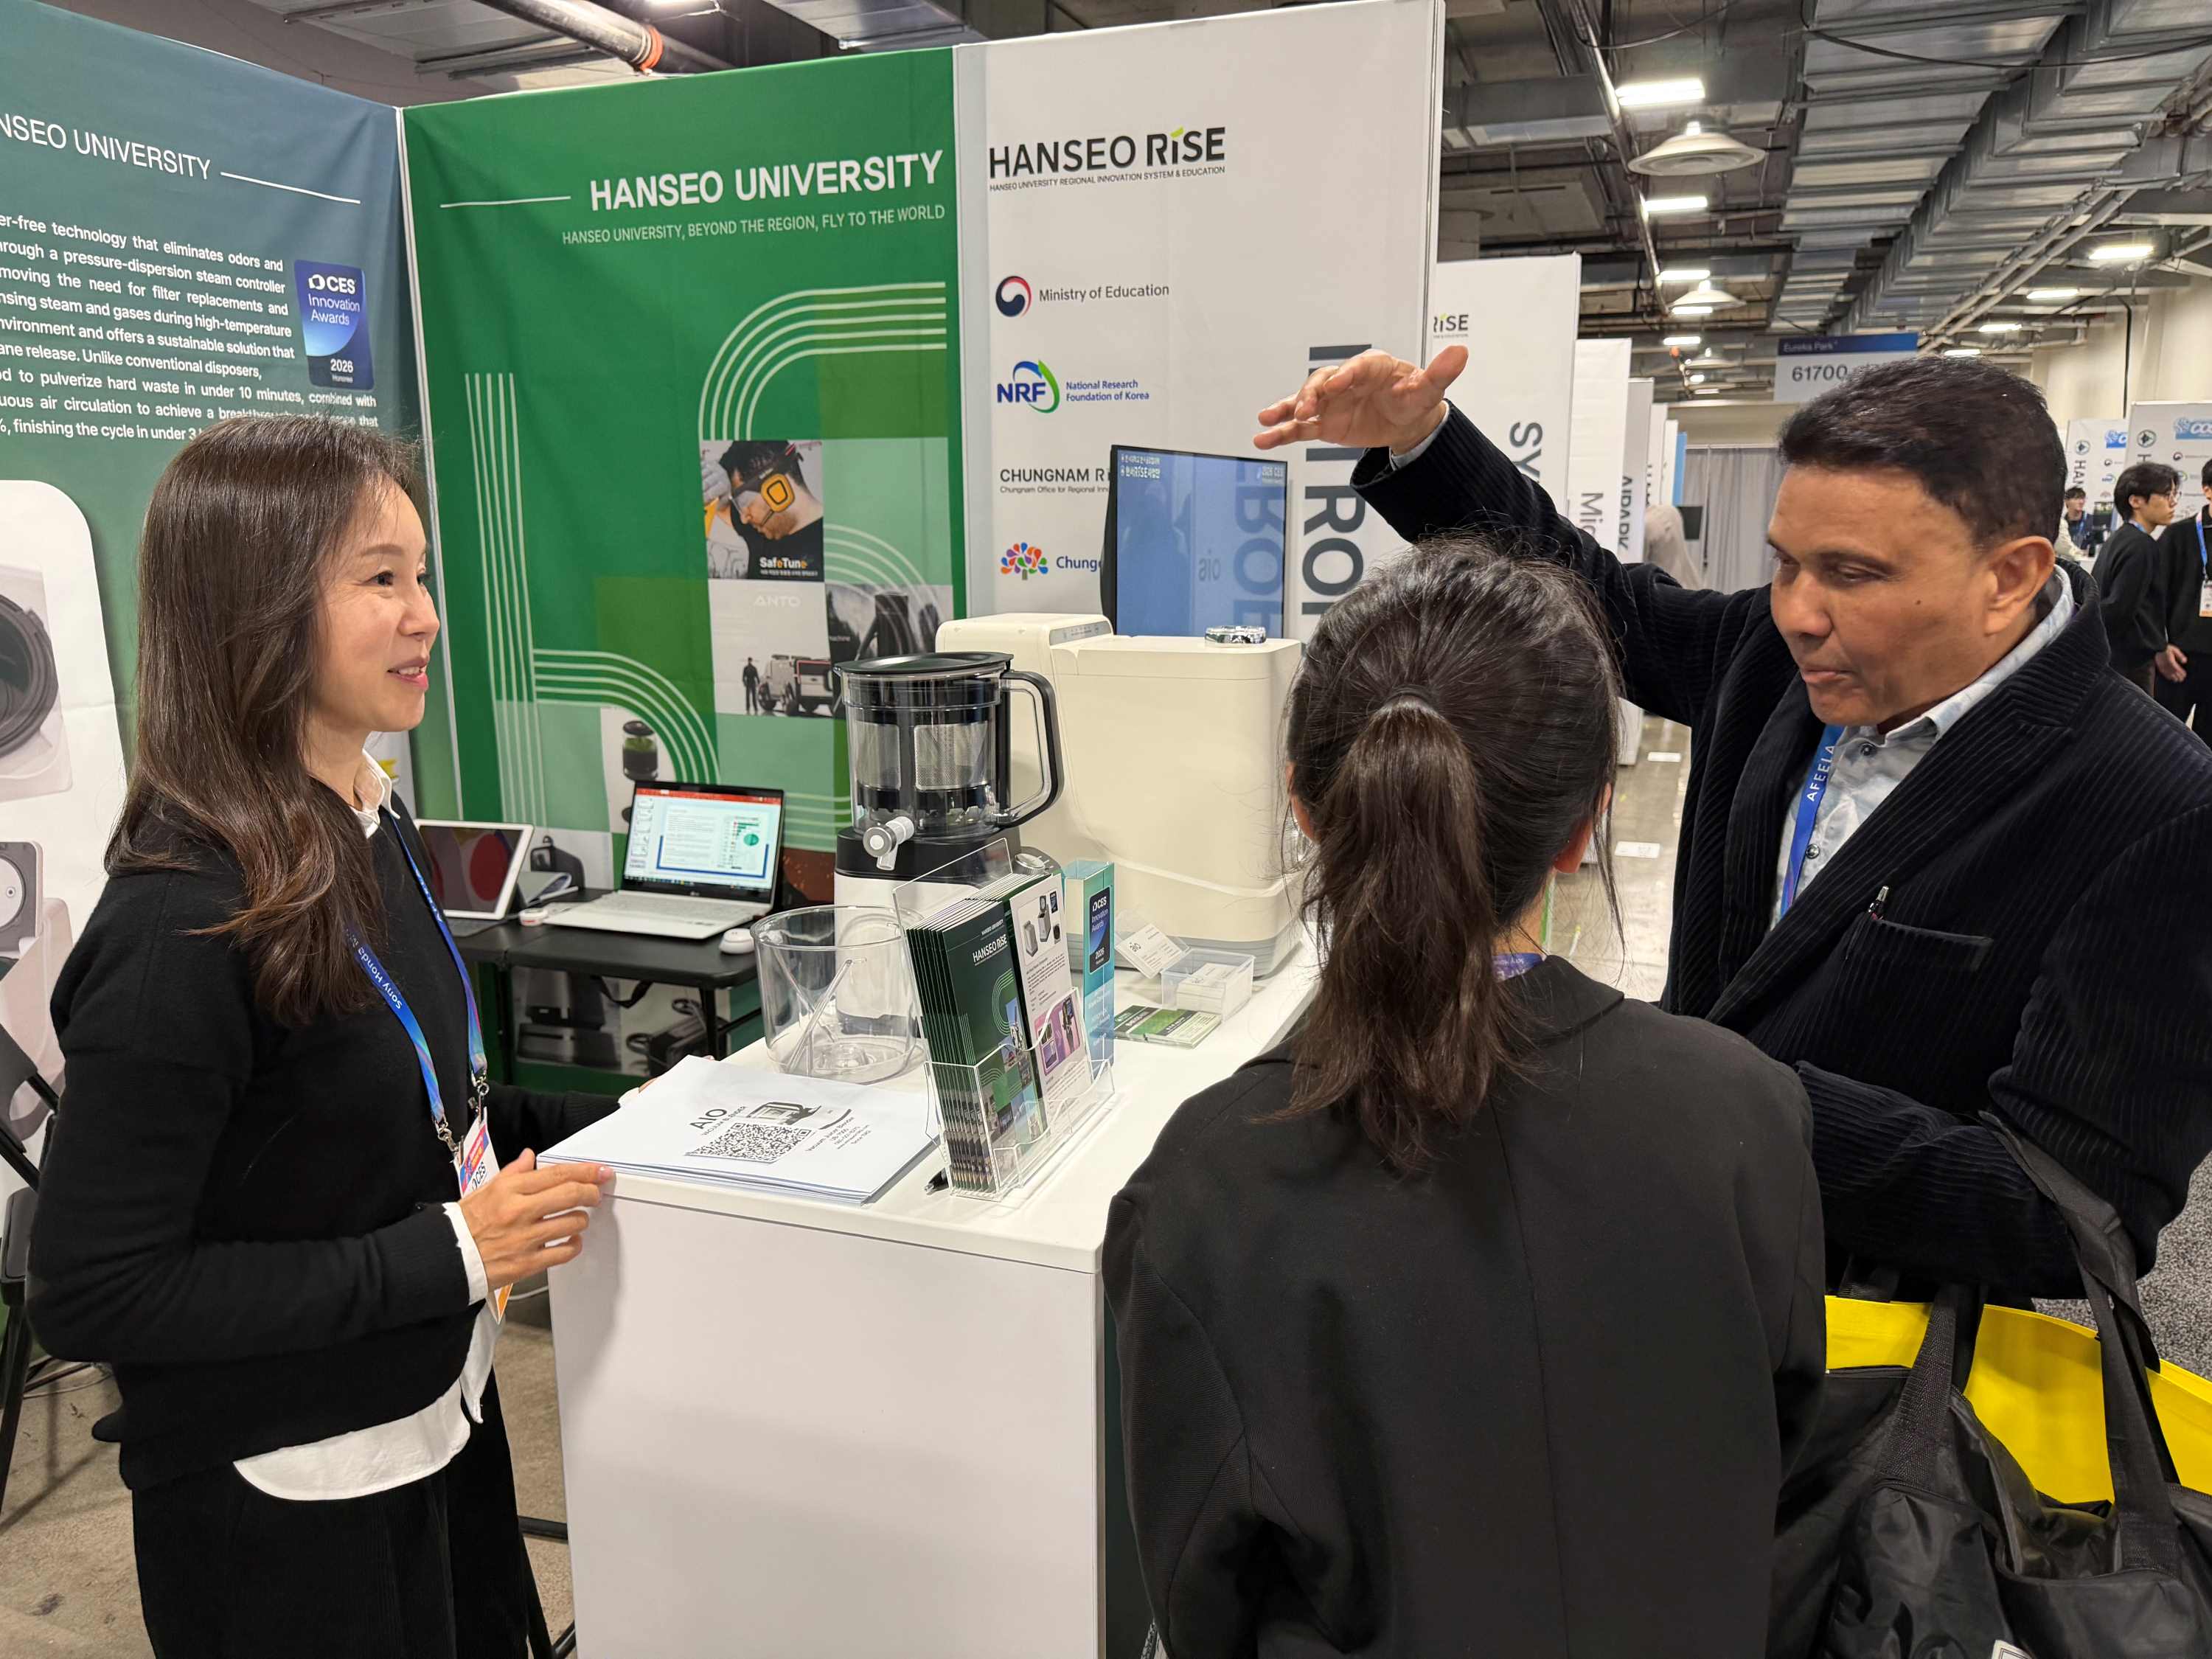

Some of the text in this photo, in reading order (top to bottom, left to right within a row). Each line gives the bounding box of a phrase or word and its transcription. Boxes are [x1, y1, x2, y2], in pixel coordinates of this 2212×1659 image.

[74, 129, 210, 179] UNIVERSITY
[990, 136, 1136, 178] HANSEO
[591, 149, 943, 211] HANSEO UNIVERSITY
[990, 182, 1017, 192] HANSEO
[1018, 179, 1058, 189] UNIVERSITY
[1060, 176, 1096, 186] REGIONAL
[1097, 173, 1142, 183] INNOVATION
[1144, 170, 1174, 181] SYSTEM
[1182, 166, 1225, 177] EDUCATION
[563, 205, 945, 244] HANSEO UNIVERSITY, BEYOND THE REGION, FLY TO THE WORLD
[52, 222, 126, 249] technology
[132, 236, 159, 251] that
[164, 242, 223, 262] eliminates
[228, 252, 260, 268] odors
[264, 260, 283, 272] and
[49, 249, 58, 260] a
[63, 250, 192, 280] pressure-dispersion
[196, 270, 232, 286] steam
[236, 277, 285, 294] controller
[58, 273, 81, 288] the
[89, 279, 121, 293] need
[128, 282, 146, 296] for
[153, 285, 181, 302] filter
[187, 292, 262, 313] replacements
[268, 303, 288, 316] and
[327, 276, 355, 295] CES
[1039, 284, 1169, 302] Ministry of Education
[308, 293, 360, 313] Innovation
[40, 297, 82, 313] steam
[86, 302, 110, 316] and
[114, 307, 151, 320] gases
[154, 310, 193, 328] during
[195, 315, 292, 338] high-temperature
[310, 310, 349, 325] Awards
[79, 327, 103, 340] and
[106, 329, 145, 344] offers
[147, 335, 155, 345] a
[157, 335, 224, 352] sustainable
[226, 341, 271, 357] solution
[272, 347, 295, 359] that
[26, 345, 80, 361] release.
[83, 349, 123, 366] Unlike
[125, 355, 203, 373] conventional
[205, 360, 262, 380] disposers,
[330, 359, 353, 373] 2026
[18, 369, 34, 383] to
[41, 372, 102, 388] pulverize
[108, 376, 136, 391] hard
[142, 380, 179, 394] waste
[184, 382, 195, 395] in
[201, 385, 234, 398] under
[239, 386, 252, 399] 10
[257, 389, 304, 405] minutes,
[309, 392, 352, 406] combined
[355, 394, 377, 407] with
[997, 383, 1046, 403] NRF
[1066, 379, 1138, 390] National Research
[1066, 391, 1150, 401] Foundation of Korea
[40, 395, 58, 410] air
[64, 397, 132, 414] circulation
[137, 402, 150, 415] to
[155, 404, 202, 418] achieve
[206, 408, 214, 419] a
[359, 414, 378, 428] that
[13, 418, 73, 437] finishing
[75, 422, 98, 437] the
[101, 425, 134, 439] cycle
[136, 425, 148, 438] in
[151, 427, 186, 440] under
[189, 428, 196, 440] 3
[1000, 468, 1089, 482] CHUNGNAM
[1068, 486, 1095, 494] Regional
[759, 557, 807, 568] SafeTune
[1056, 556, 1102, 572] Chung
[1806, 745, 1835, 802] AFEELA
[973, 941, 997, 963] HANSEO
[358, 947, 403, 1009] Sony Honda
[690, 1108, 727, 1130] AIO
